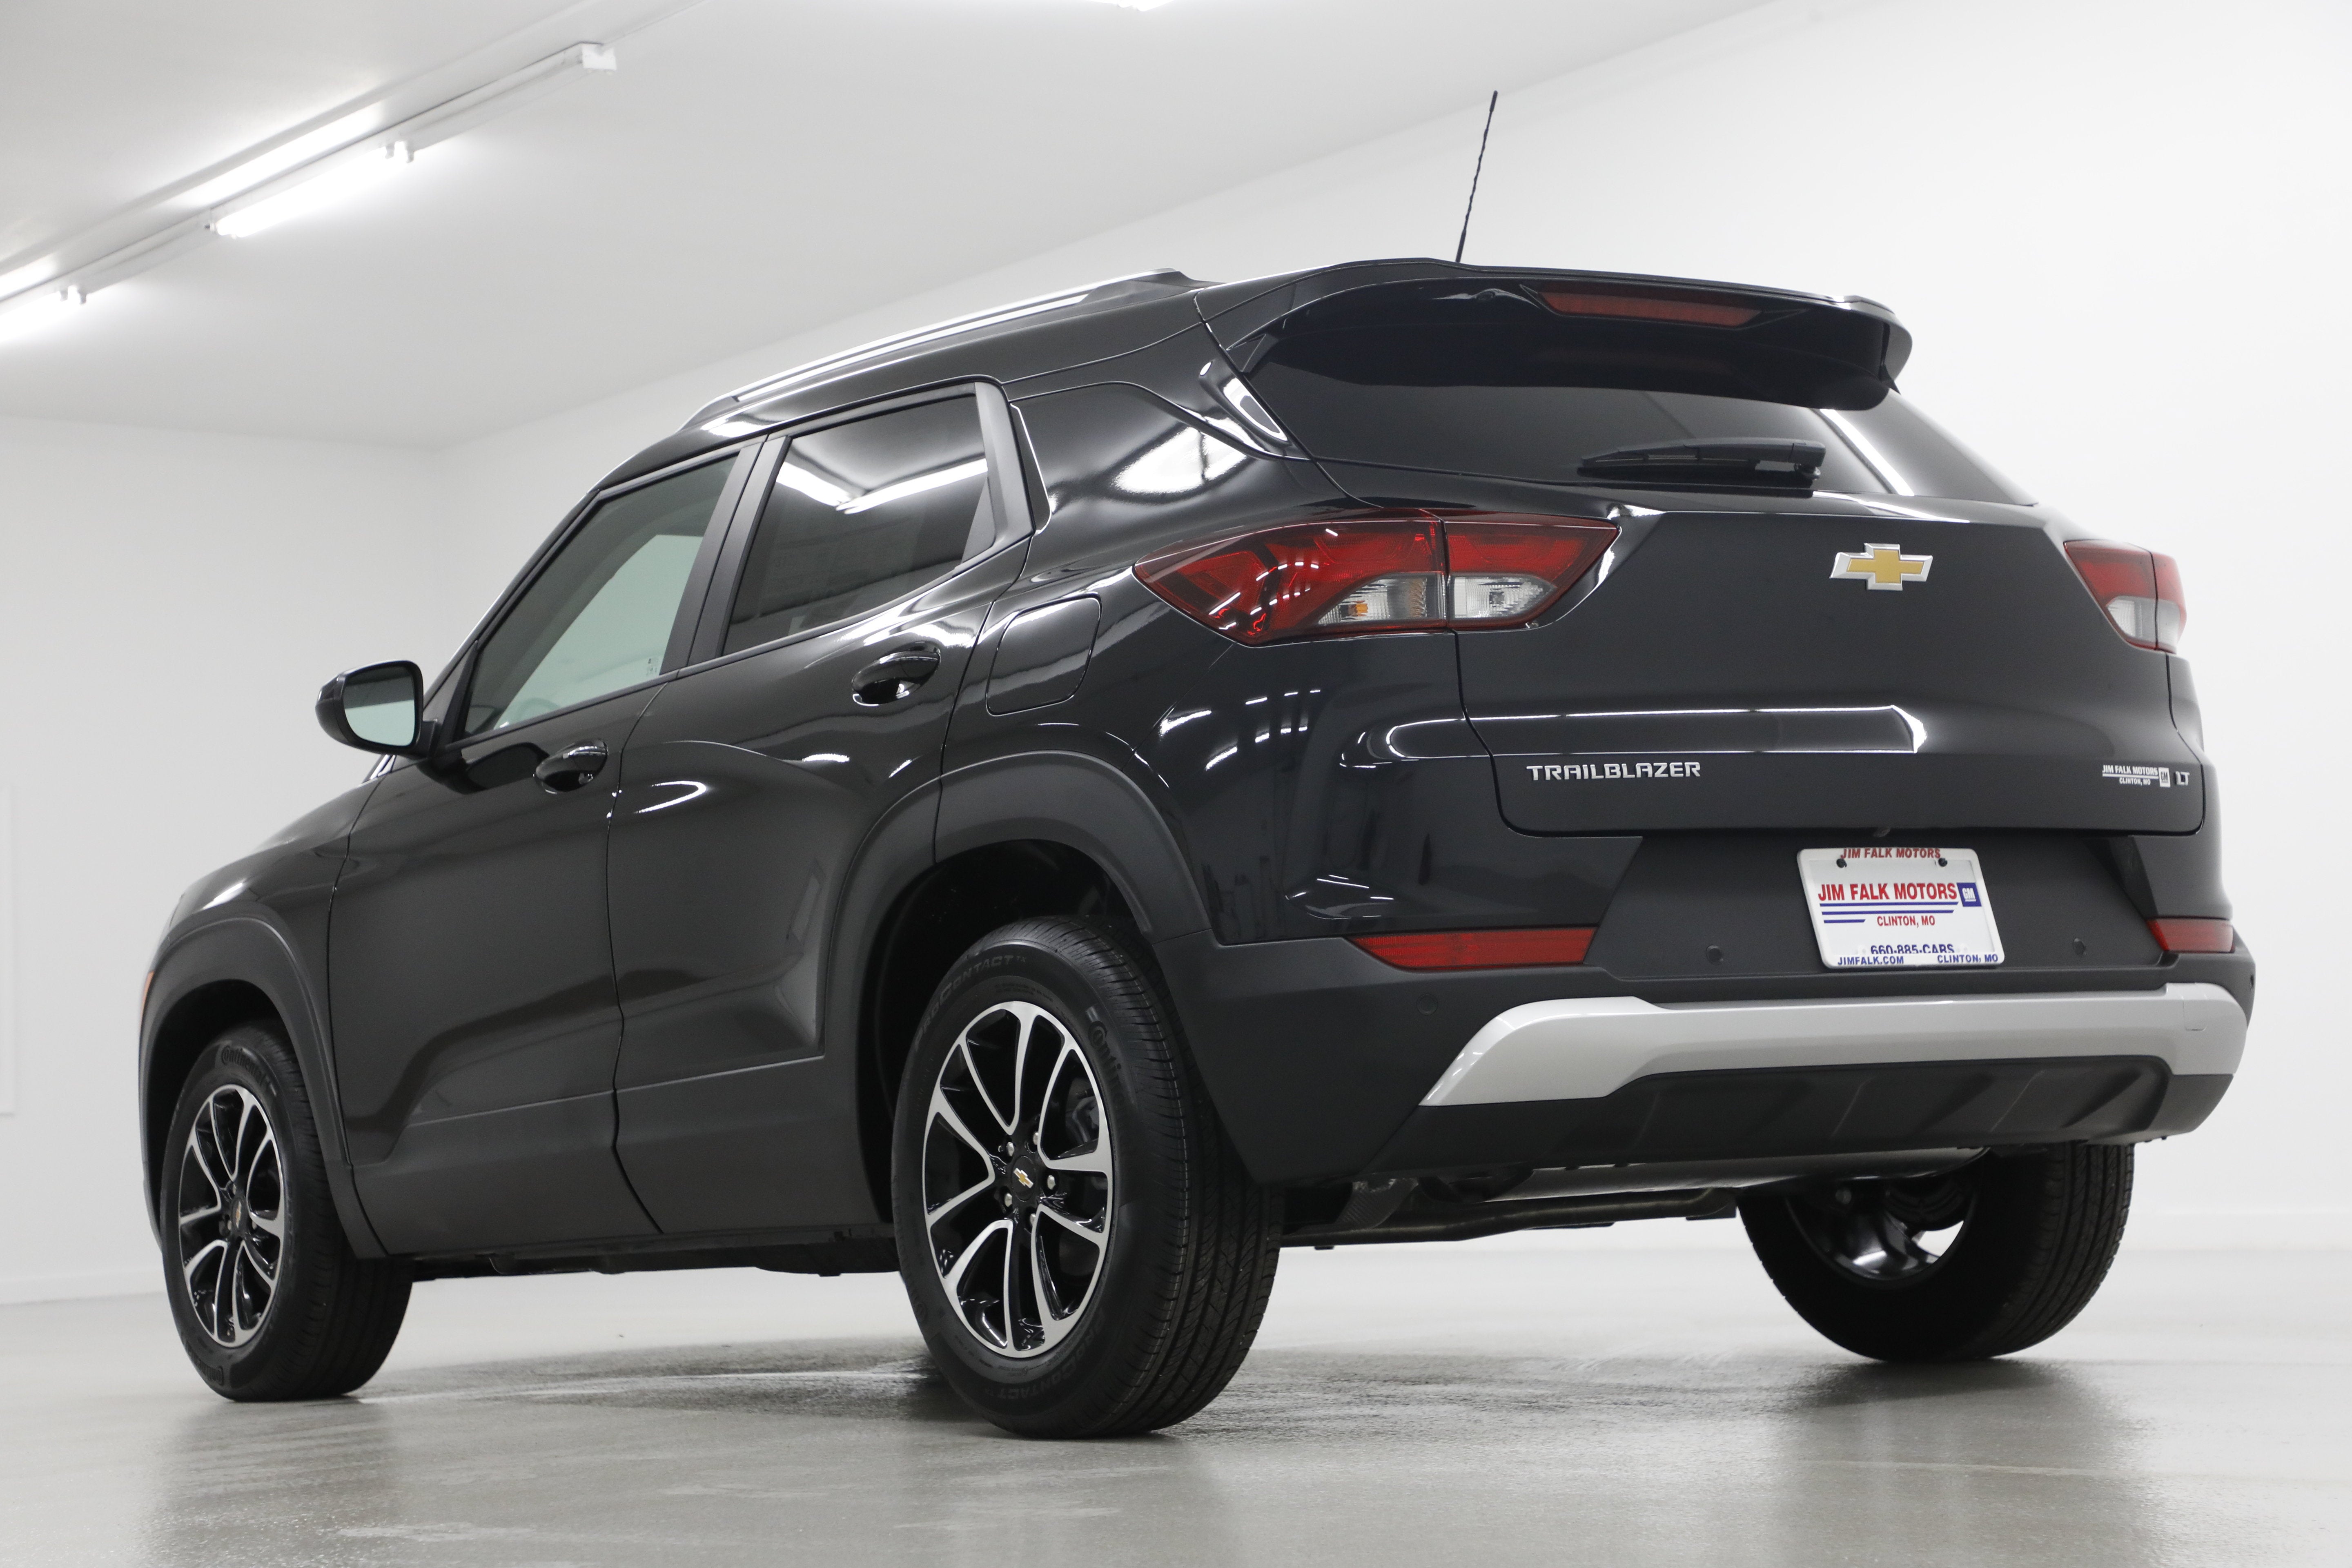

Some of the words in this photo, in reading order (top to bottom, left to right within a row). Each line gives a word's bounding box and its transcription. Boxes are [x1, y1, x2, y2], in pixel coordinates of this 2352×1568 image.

[1526, 762, 1701, 781] TRAILBLAZER
[2102, 764, 2114, 773] JIM
[2115, 765, 2131, 774] FALK
[2132, 766, 2158, 775] MOTORS
[1841, 848, 1860, 859] JIM
[1864, 848, 1892, 858] FALK
[1896, 847, 1941, 858] MOTORS
[1818, 884, 1845, 901] JIM
[1850, 883, 1889, 900] FALK
[1894, 883, 1958, 899] MOTORS
[1962, 887, 1975, 899] GM
[1877, 916, 1920, 928] CLINTON,
[1922, 916, 1936, 926] MO
[1838, 956, 1904, 965] JIMFALK.COM
[1984, 954, 1998, 962] MO
